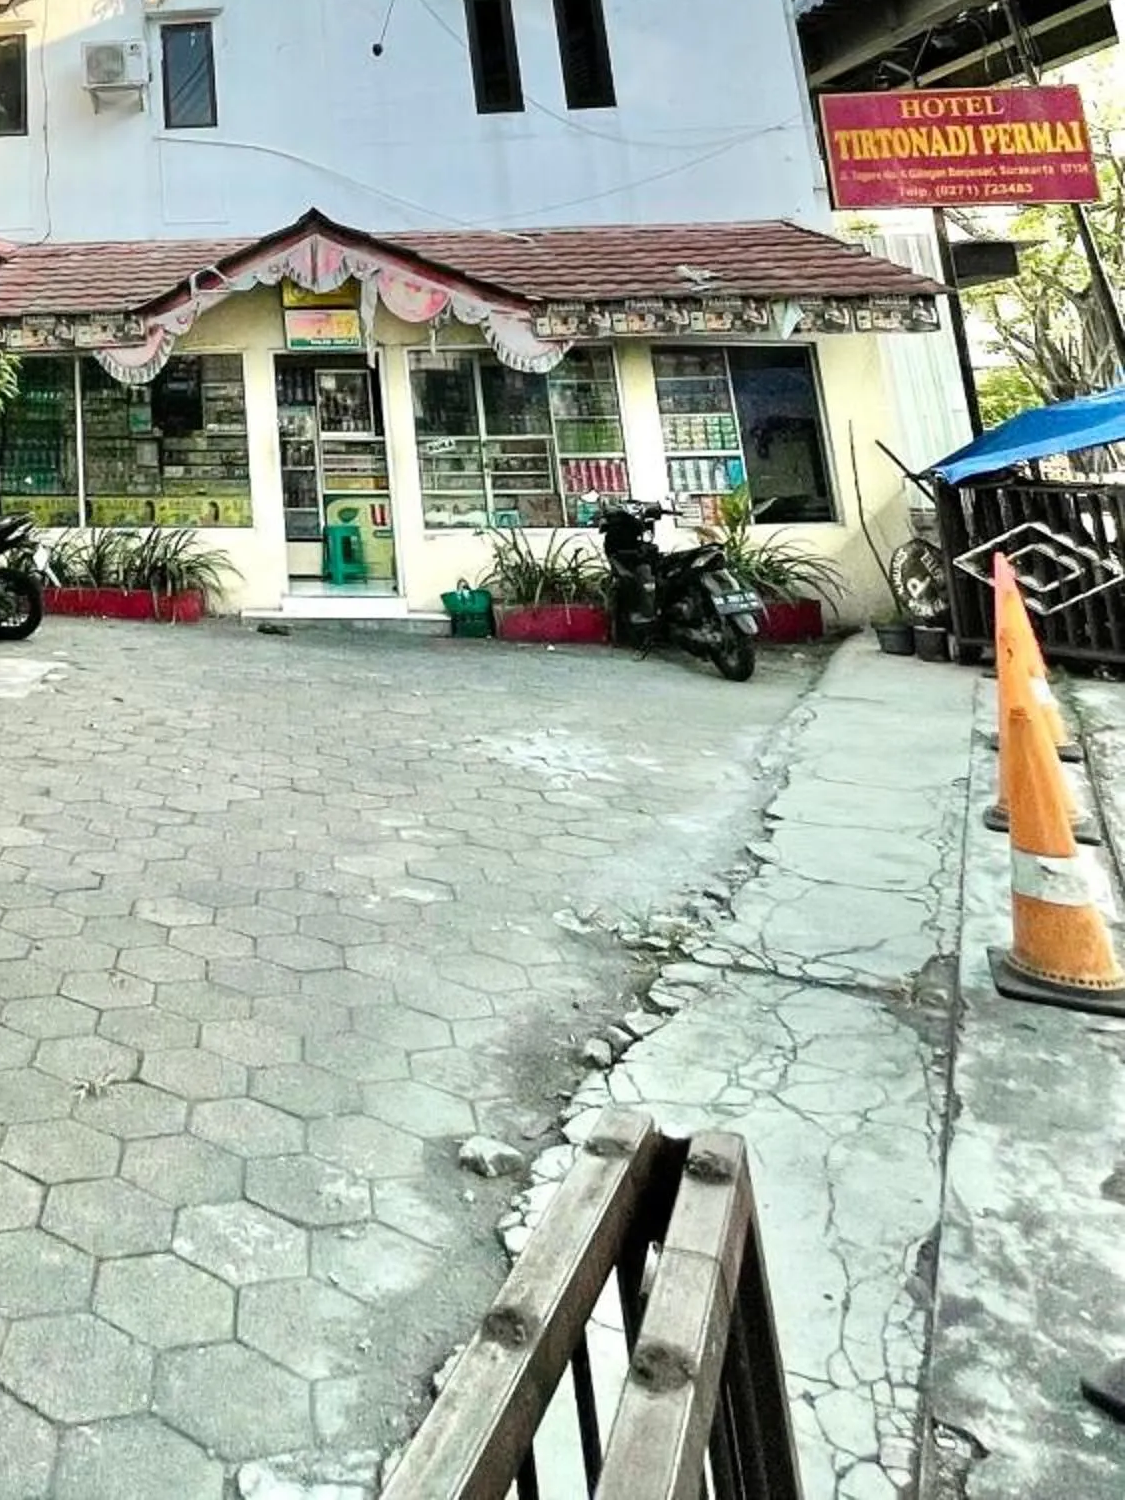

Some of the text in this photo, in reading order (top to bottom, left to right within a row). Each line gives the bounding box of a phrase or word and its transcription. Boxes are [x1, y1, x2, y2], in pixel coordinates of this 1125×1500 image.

[900, 95, 1004, 119] HOTEL
[835, 121, 1085, 161] TIRTONADI PERMAI
